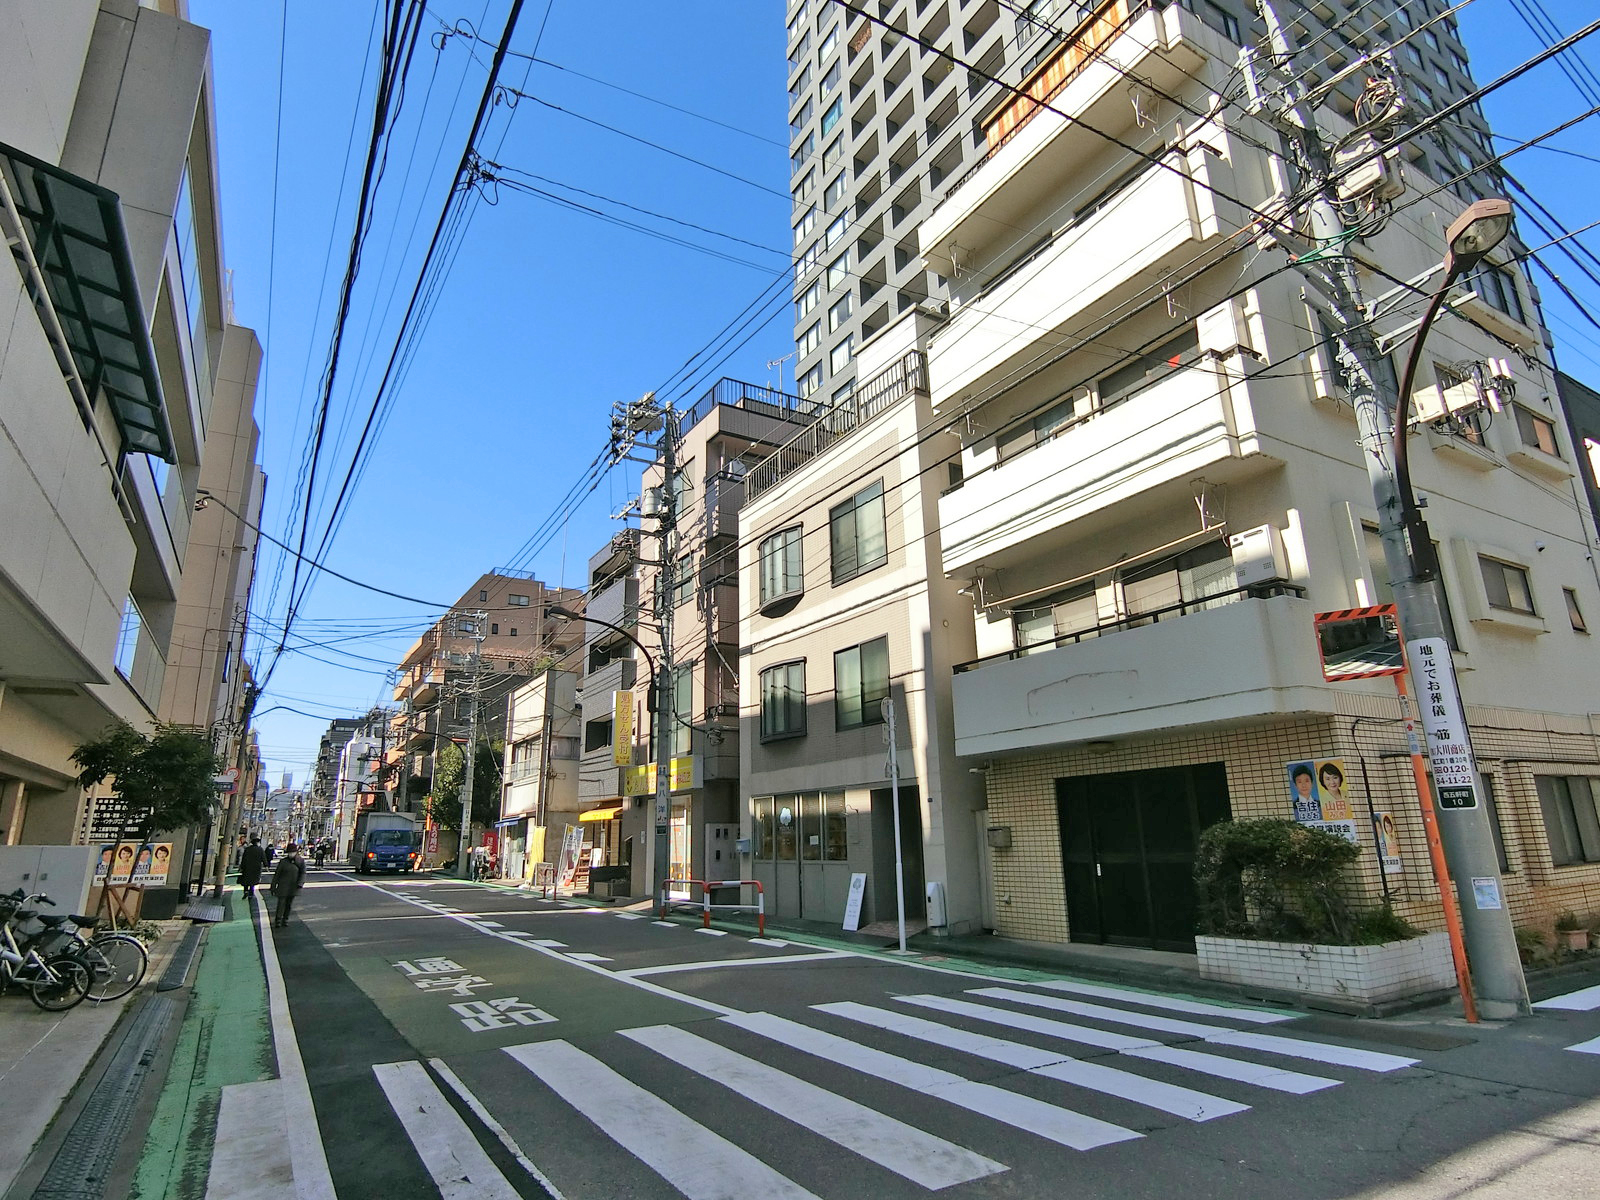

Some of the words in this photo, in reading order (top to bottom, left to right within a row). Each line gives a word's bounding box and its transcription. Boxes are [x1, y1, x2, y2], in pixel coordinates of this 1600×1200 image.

[1419, 644, 1450, 741] 地元でお葬儀一筋
[619, 693, 631, 755] 処方せん受付
[1442, 764, 1469, 774] 0120-
[1443, 790, 1469, 799] 西五軒町
[1297, 801, 1318, 812] 吉住
[1325, 800, 1347, 811] 山田
[1452, 798, 1463, 806] 10
[1300, 811, 1319, 819] はるお
[392, 956, 560, 1033] 通学路
